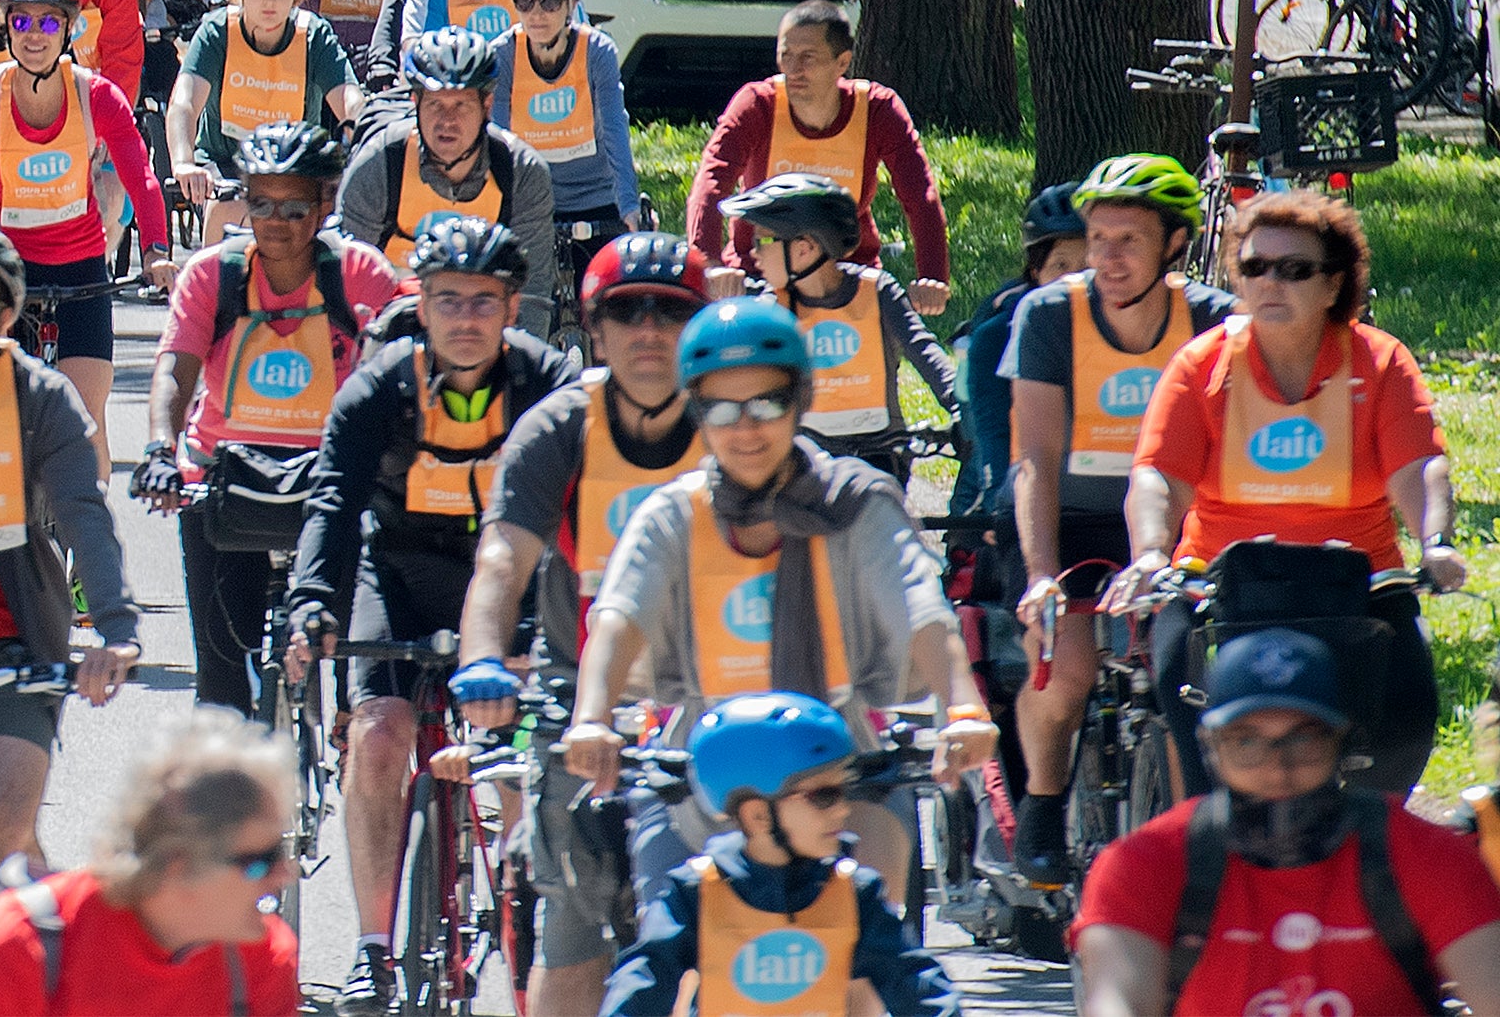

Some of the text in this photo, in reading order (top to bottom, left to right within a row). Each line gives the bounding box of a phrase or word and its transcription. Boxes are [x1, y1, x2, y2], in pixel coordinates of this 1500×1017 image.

[471, 11, 510, 33] lait
[246, 75, 299, 92] Desjardins
[232, 103, 254, 115] TOUR
[532, 90, 576, 115] lait
[23, 155, 70, 178] lait
[794, 161, 855, 179] Desjardins
[805, 327, 860, 356] lait
[255, 355, 311, 388] lait
[1106, 374, 1153, 407] lai
[238, 404, 273, 416] TOUR
[1257, 423, 1326, 460] lait
[742, 943, 819, 986] lait
